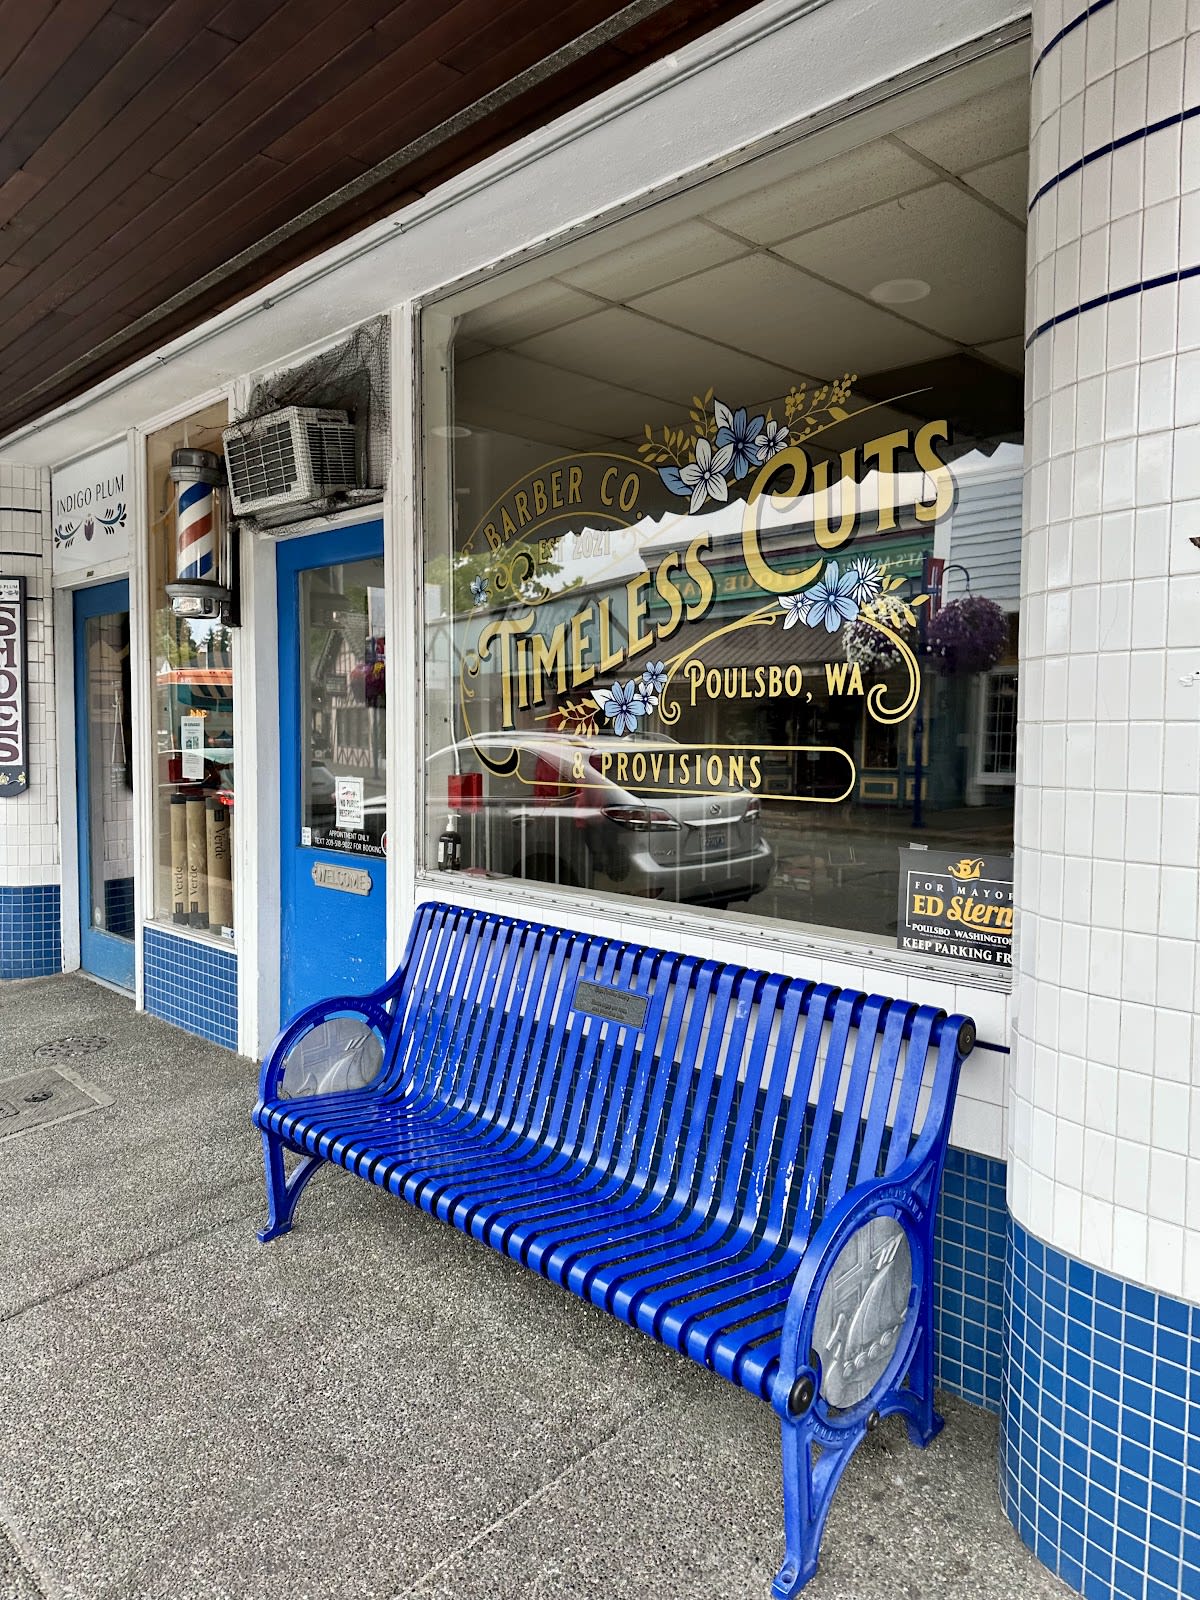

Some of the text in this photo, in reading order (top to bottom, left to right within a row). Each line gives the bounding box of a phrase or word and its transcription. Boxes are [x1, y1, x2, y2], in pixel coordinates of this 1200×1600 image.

[57, 473, 124, 517] INDIGO PLUM
[483, 466, 644, 554] BARBER CO.
[537, 535, 565, 565] EST
[478, 419, 957, 731] TIMELESS CUTS
[684, 659, 865, 706] POULSBO, WA
[572, 752, 762, 789] & PROVISIONS
[214, 826, 226, 860] Verde
[314, 837, 325, 845] TEXT
[362, 844, 382, 854] BOOKING
[328, 829, 370, 842] APPOINTMENT ONLY
[174, 866, 183, 897] Verde
[190, 865, 199, 896] Verde
[319, 869, 366, 891] WELCOME
[915, 881, 944, 893] FOR
[912, 894, 1013, 934] ED Stern
[912, 923, 951, 937] POULSBO
[902, 937, 932, 951] KEEP
[934, 942, 992, 961] PARKING
